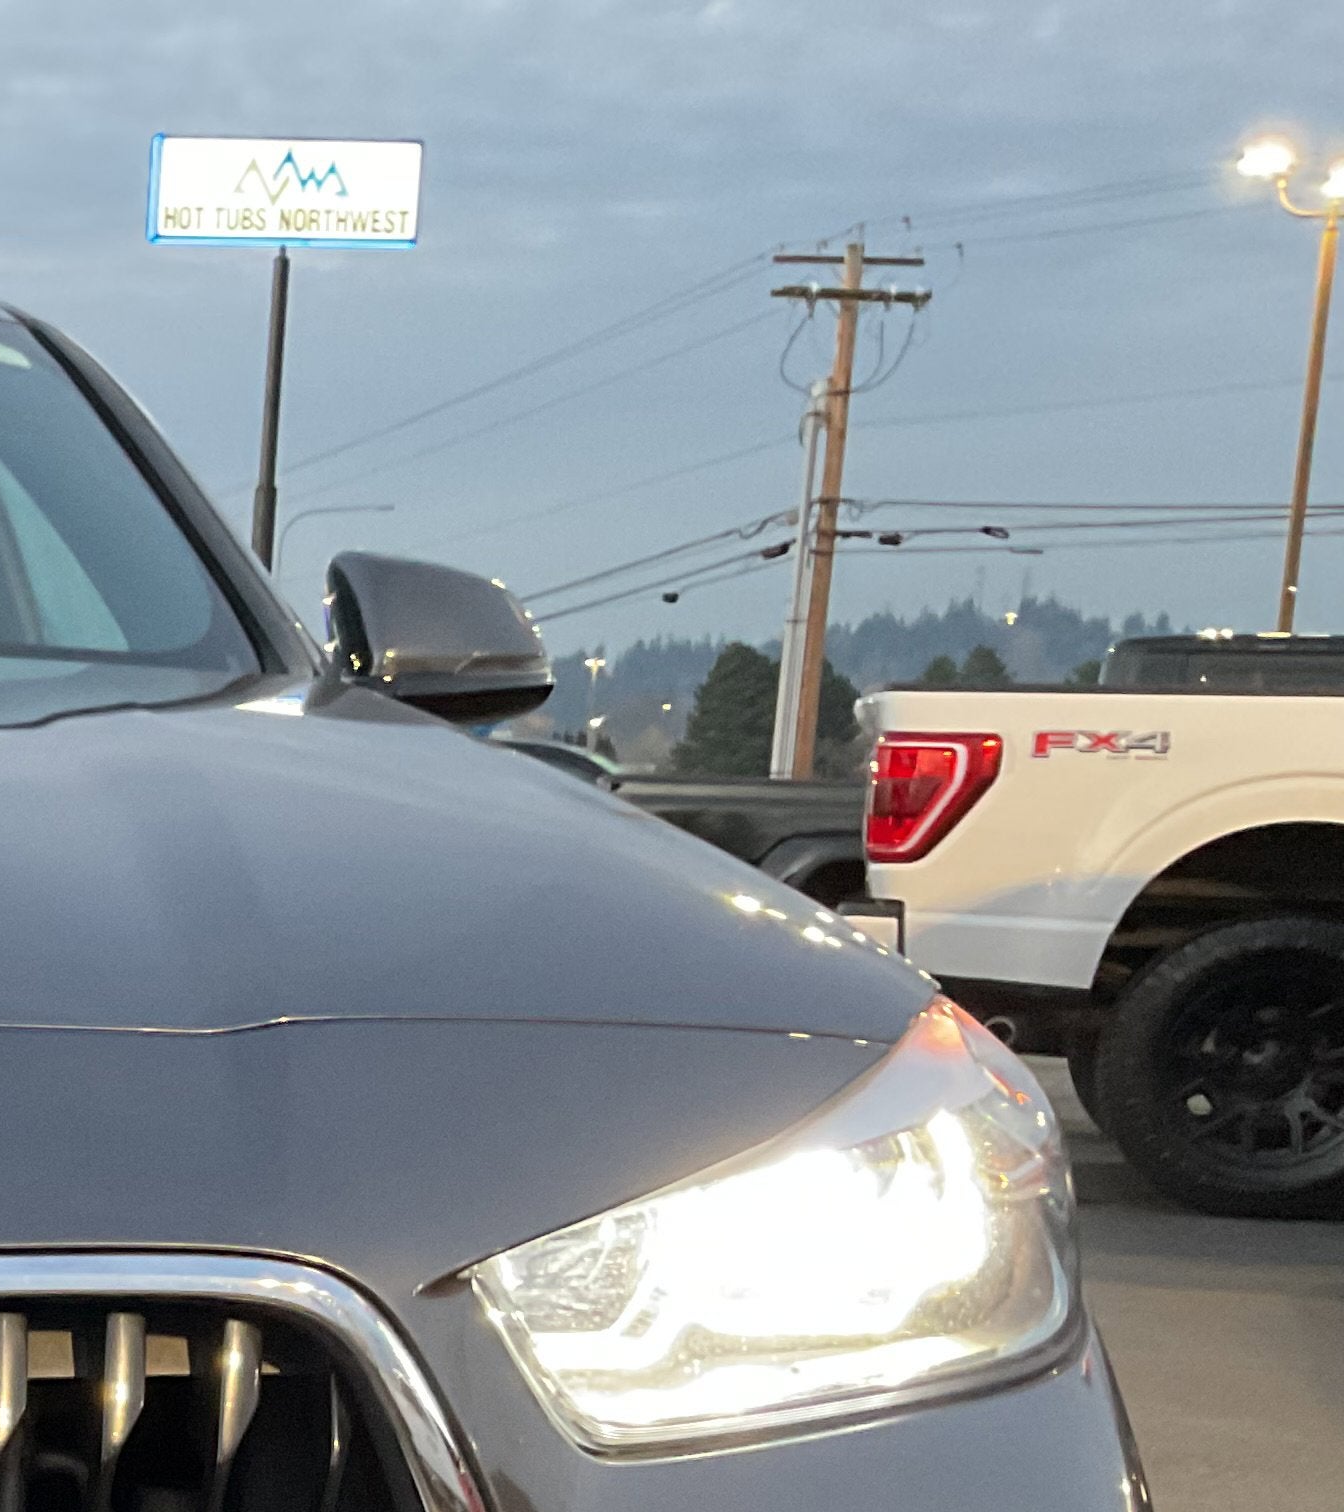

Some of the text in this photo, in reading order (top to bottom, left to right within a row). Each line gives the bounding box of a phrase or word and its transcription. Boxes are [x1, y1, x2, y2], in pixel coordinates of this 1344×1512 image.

[164, 206, 409, 234] HOT TUBS NORTHWEST
[1031, 730, 1171, 758] FX4
